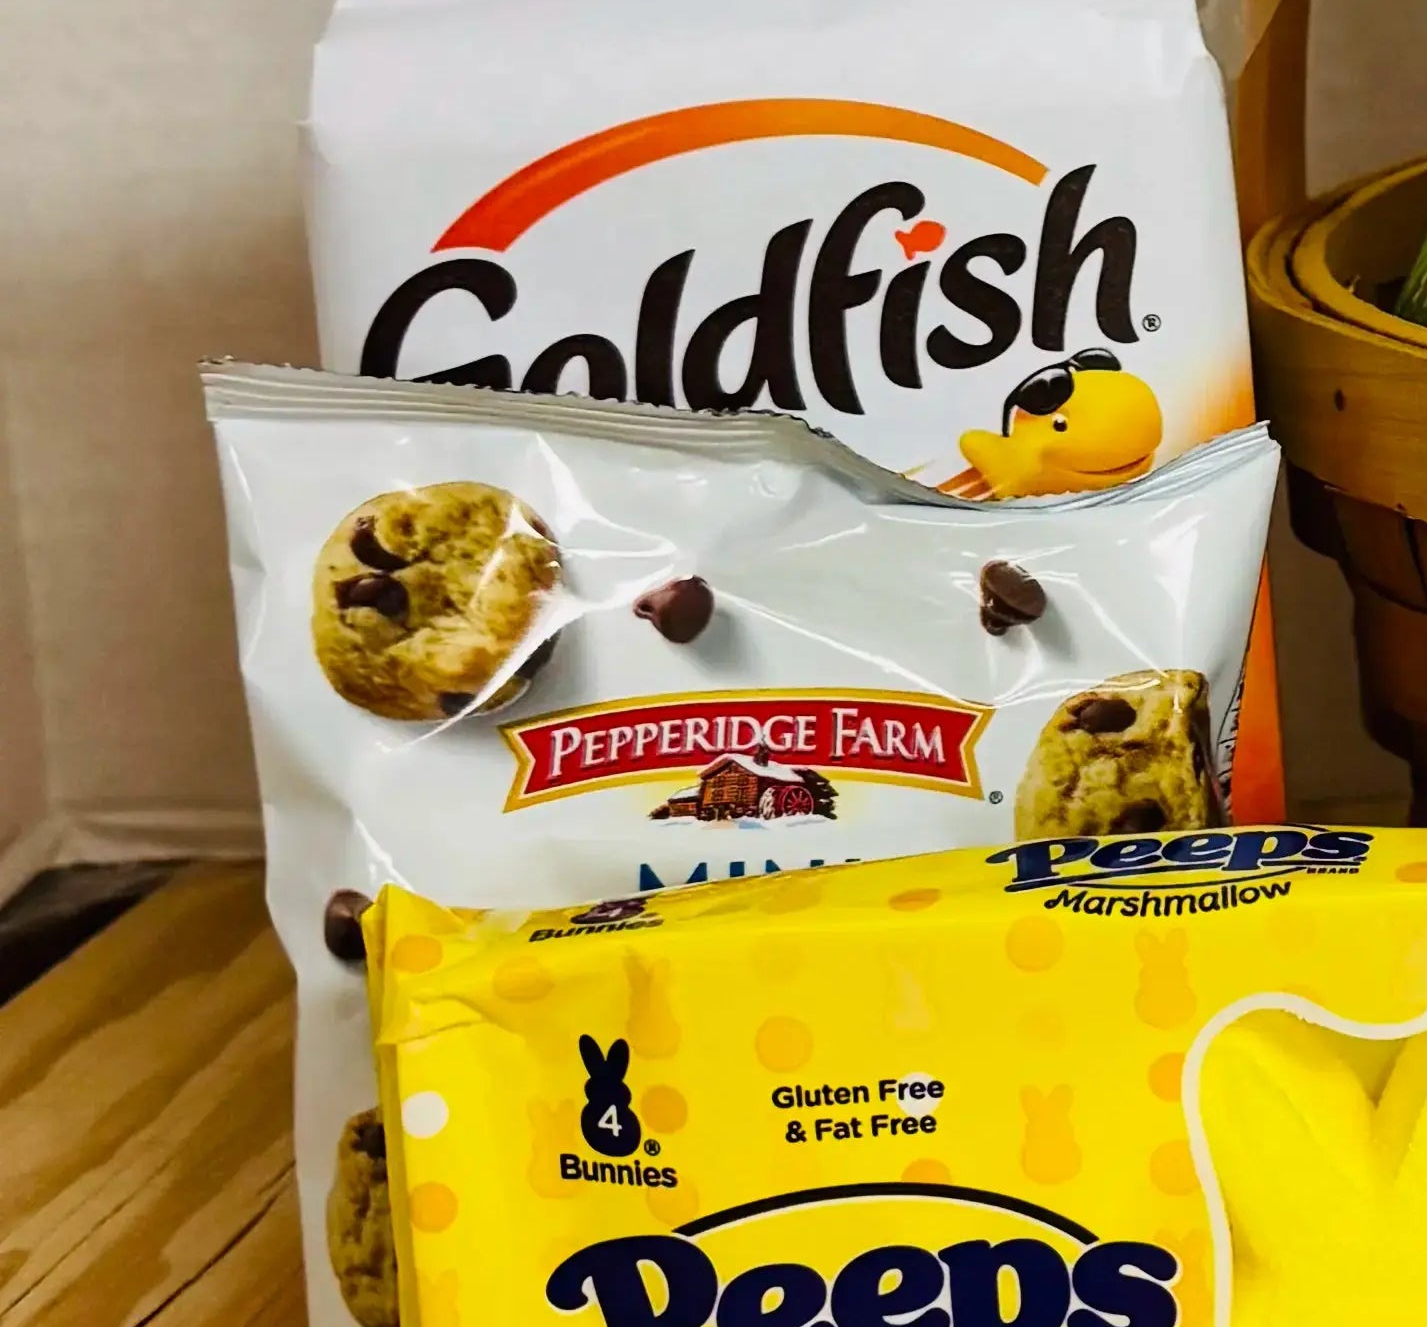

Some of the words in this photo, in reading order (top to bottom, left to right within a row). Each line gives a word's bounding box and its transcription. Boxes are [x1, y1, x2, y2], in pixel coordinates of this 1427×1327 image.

[360, 164, 1142, 413] Goldfish
[550, 715, 816, 780] PEPPERIDGE
[832, 708, 946, 764] FARM
[985, 831, 1374, 880] Peeps
[1043, 881, 1292, 918] Marshmallow
[772, 1083, 869, 1110] Gluten
[878, 1077, 944, 1103] Free
[598, 1105, 622, 1136] 4
[785, 1120, 806, 1143] &
[815, 1118, 863, 1141] Fat
[870, 1113, 937, 1137] Free
[560, 1153, 678, 1188] Bunnies
